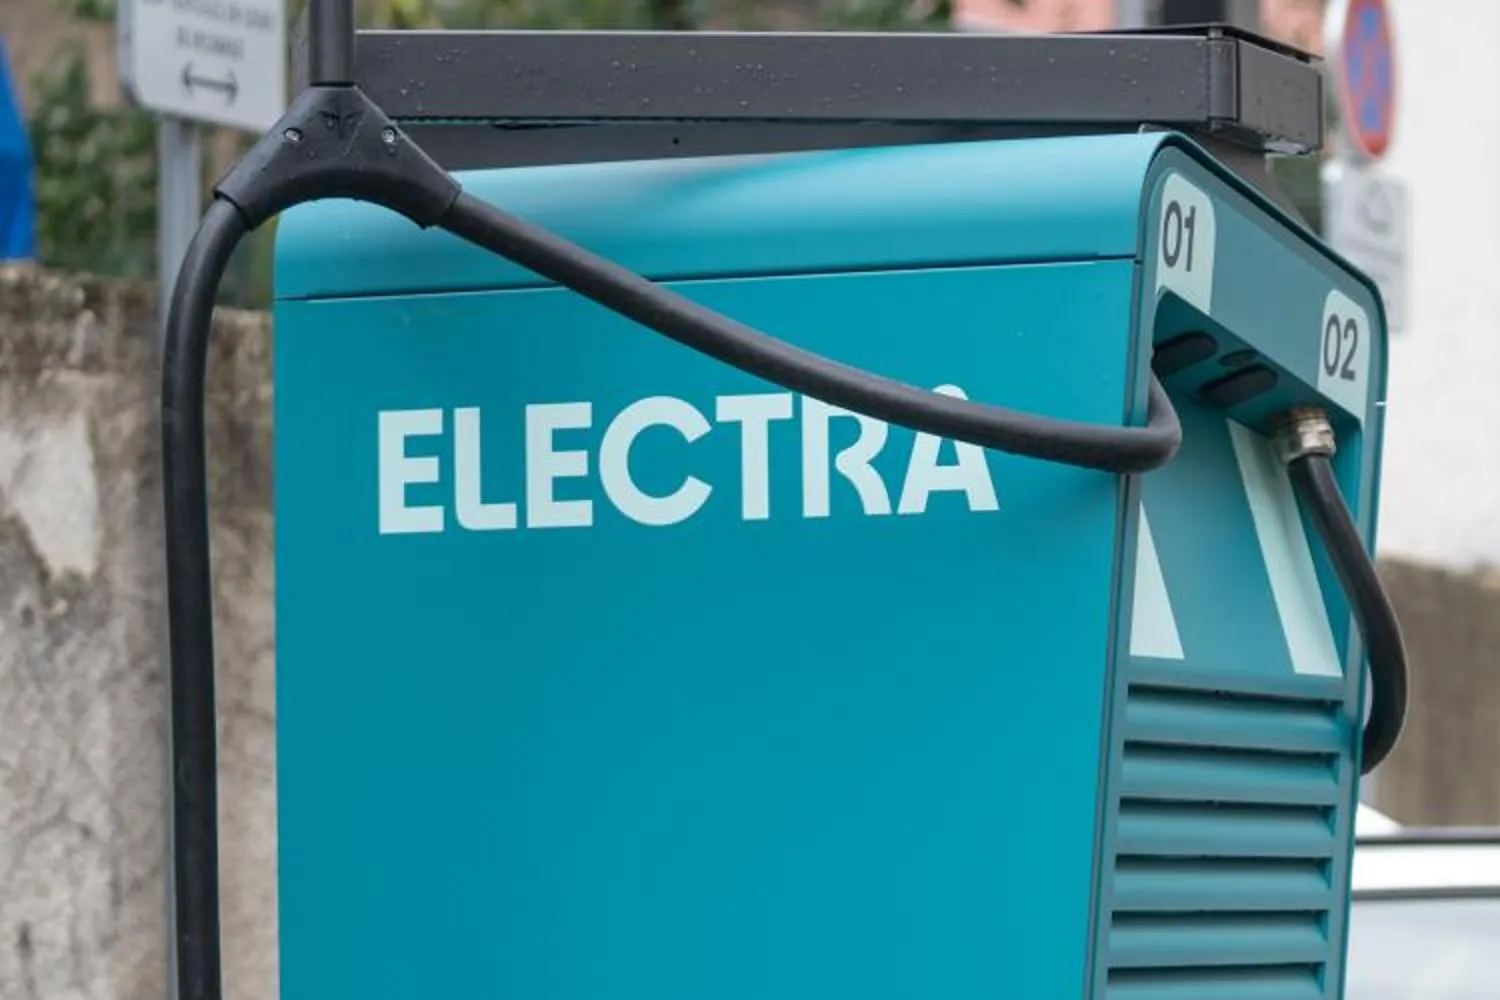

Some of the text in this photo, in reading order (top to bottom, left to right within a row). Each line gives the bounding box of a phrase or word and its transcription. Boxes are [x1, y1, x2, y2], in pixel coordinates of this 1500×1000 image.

[1160, 199, 1197, 273] 01
[1323, 312, 1358, 382] 02
[378, 384, 1000, 535] ELECTRA
